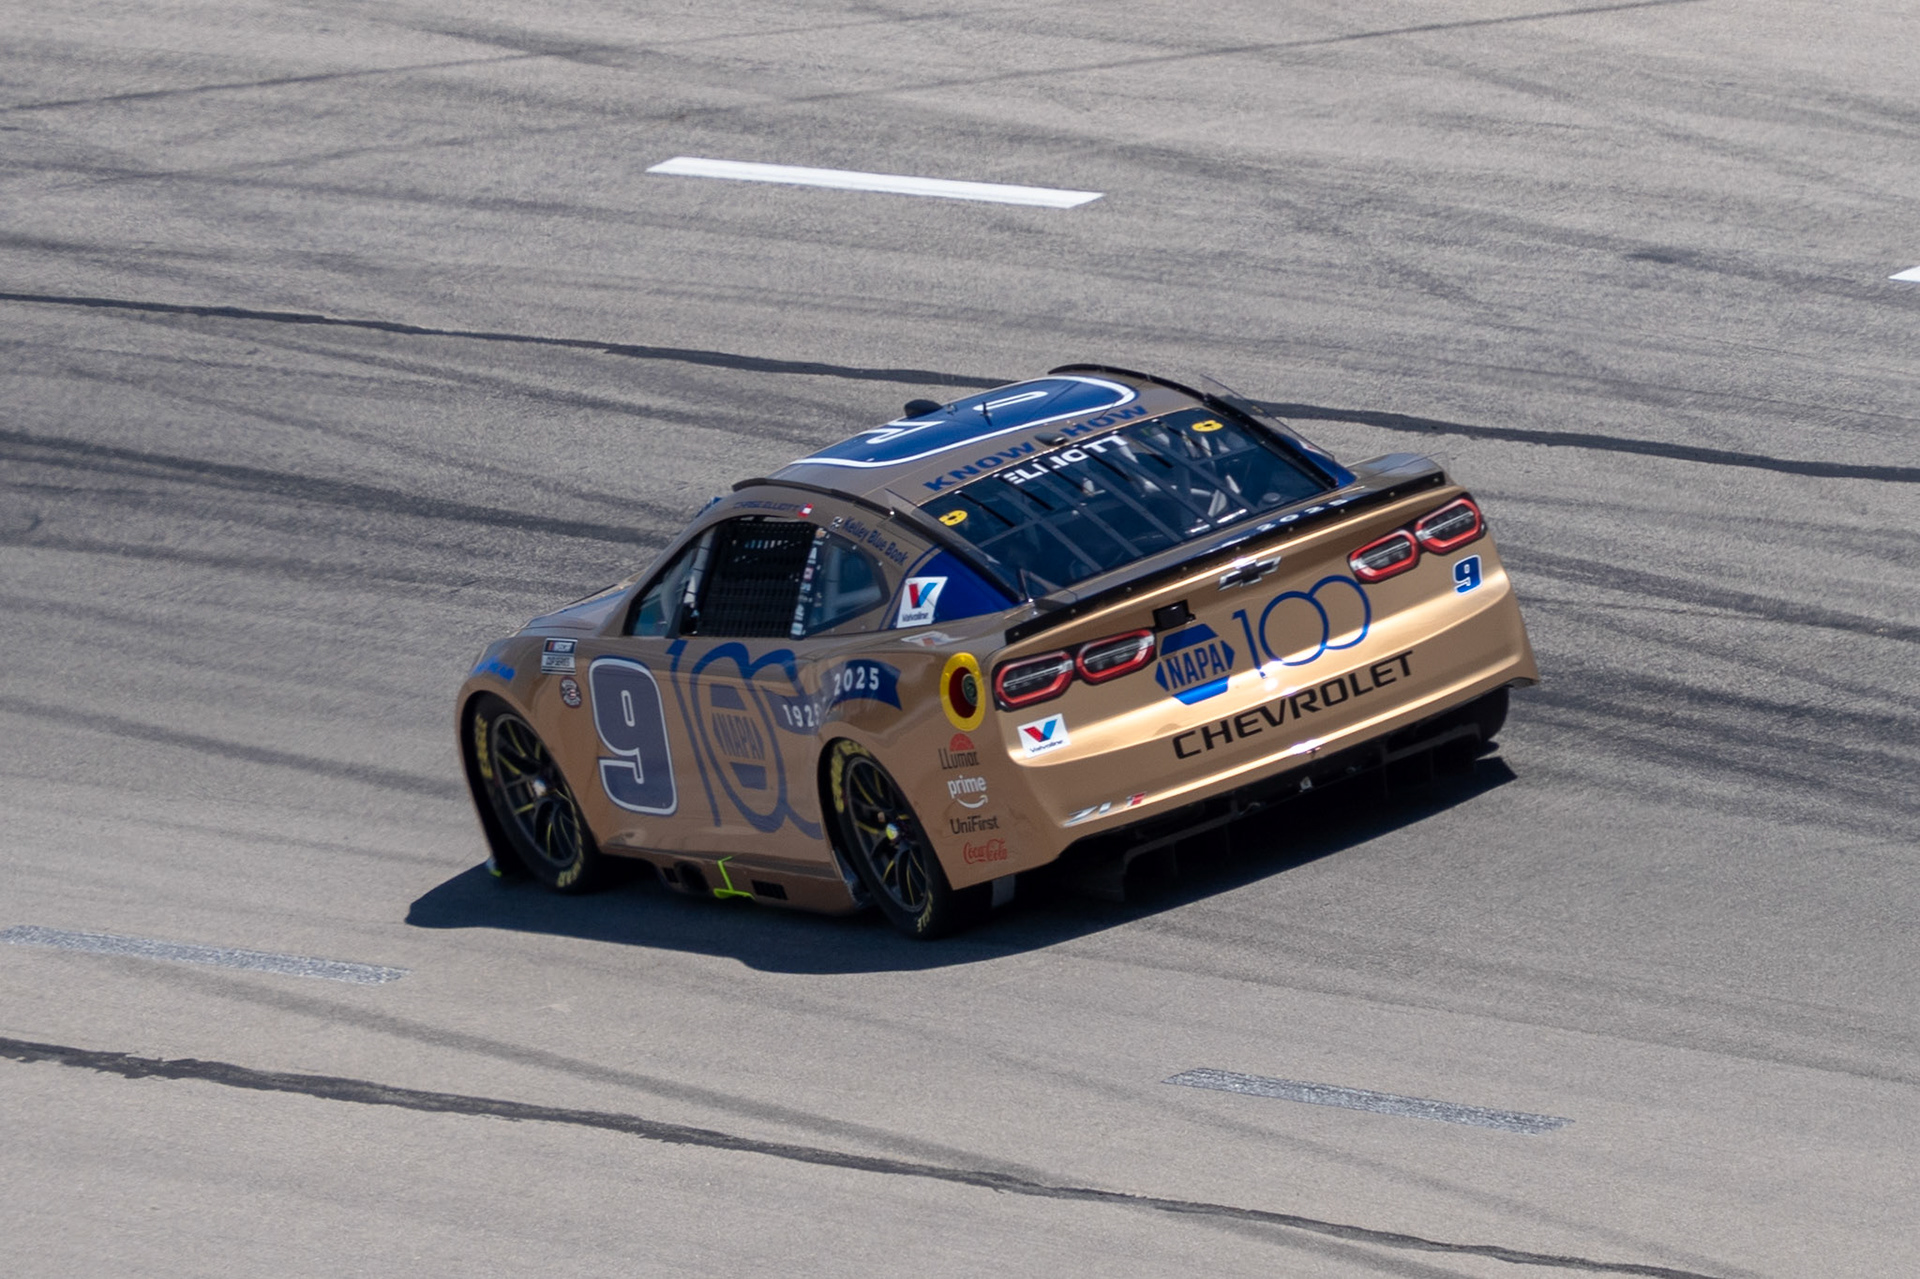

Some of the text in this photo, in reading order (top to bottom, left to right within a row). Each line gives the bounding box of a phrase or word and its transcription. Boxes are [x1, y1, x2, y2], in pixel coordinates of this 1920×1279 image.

[922, 405, 1149, 492] KNOW HOW
[842, 516, 909, 566] Kelley Blue Book
[1452, 554, 1484, 595] 9
[1232, 574, 1372, 680] 100
[833, 665, 881, 697] 2025
[1166, 642, 1228, 690] NAPA
[1172, 650, 1414, 760] CHEVROLET
[588, 656, 678, 817] 9
[947, 775, 987, 799] prime
[950, 815, 1000, 835] UniFirst
